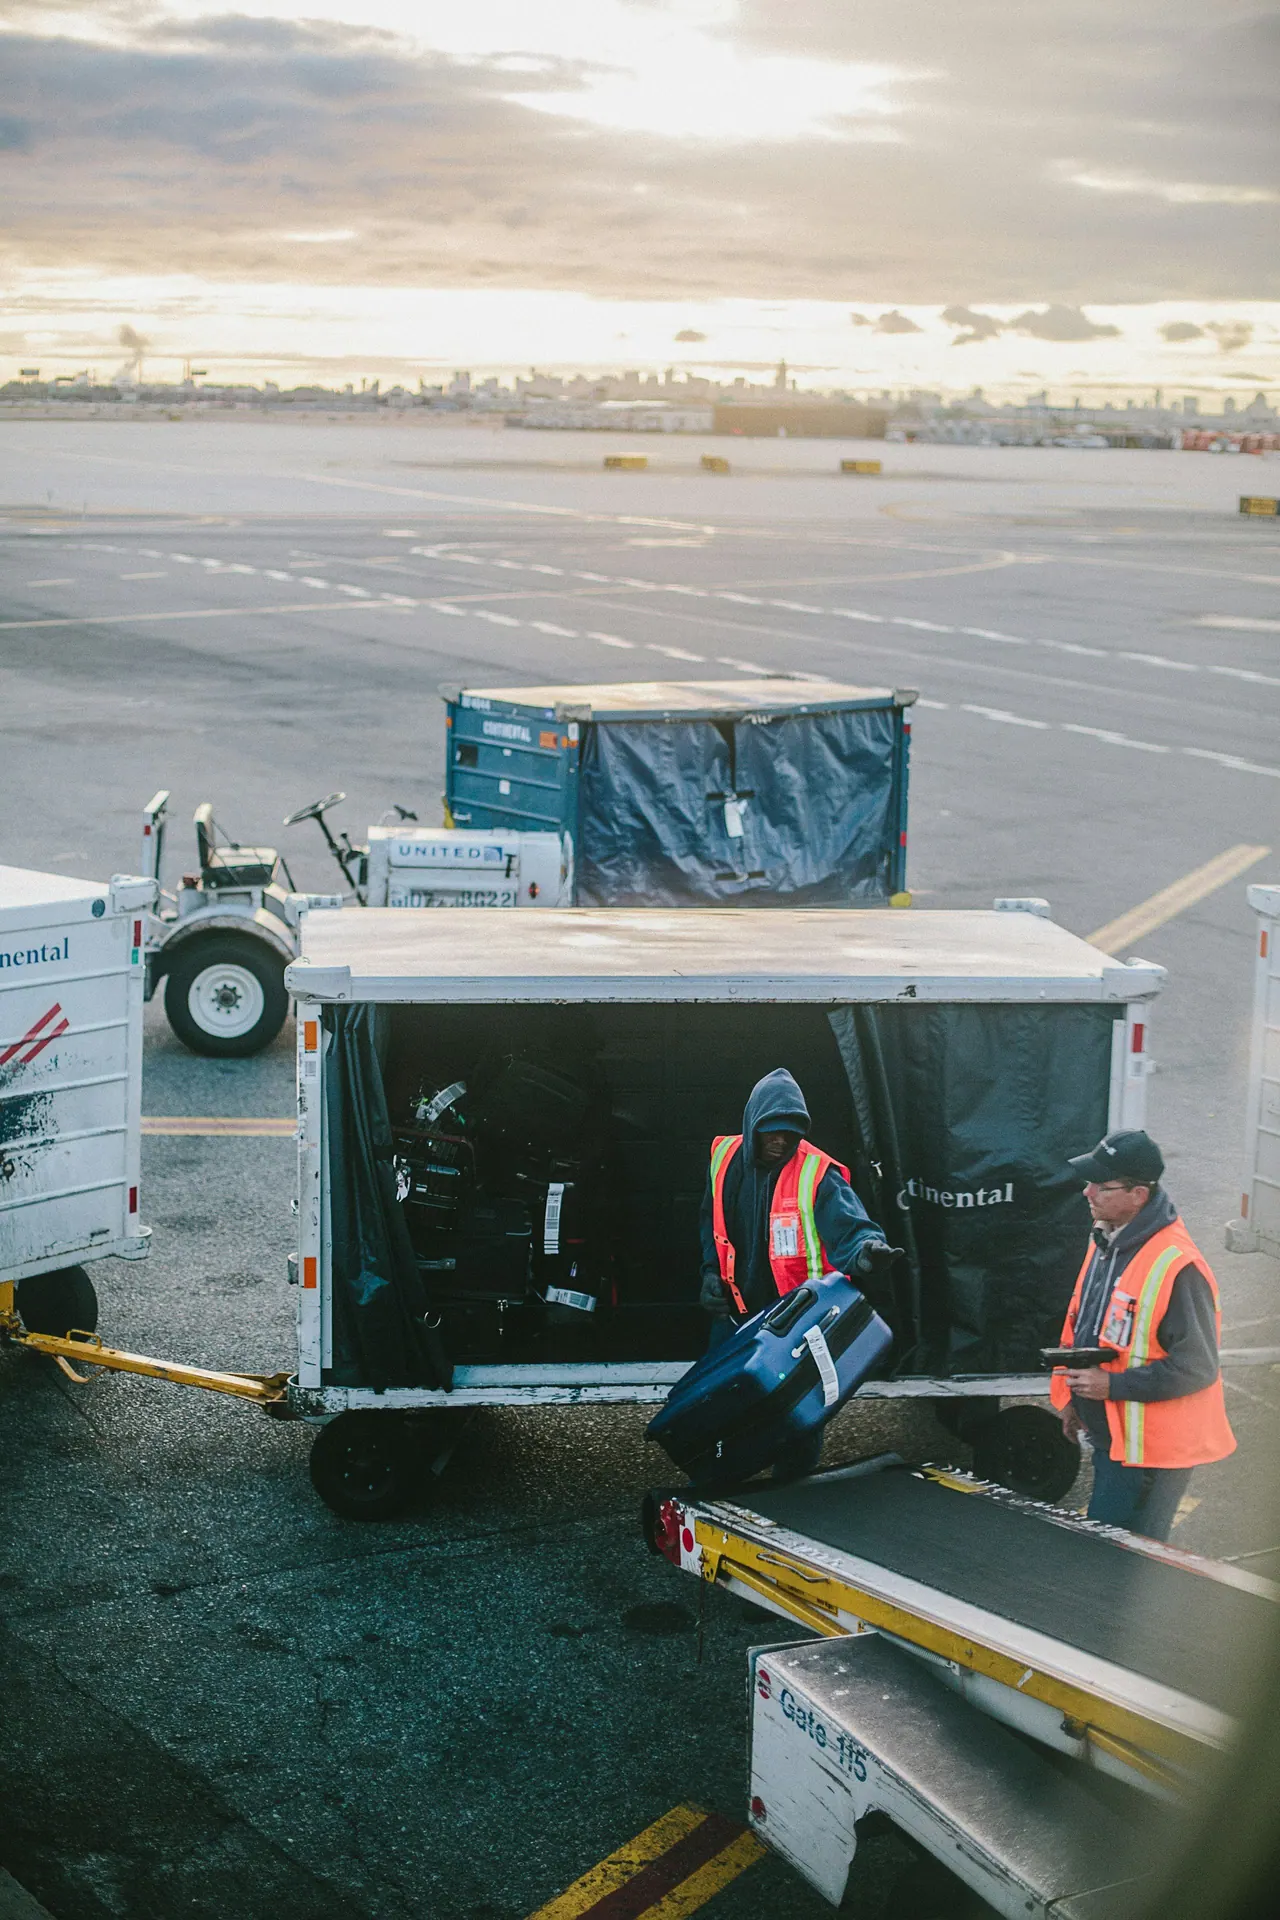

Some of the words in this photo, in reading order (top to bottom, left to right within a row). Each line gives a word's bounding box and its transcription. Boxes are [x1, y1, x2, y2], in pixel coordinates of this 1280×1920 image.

[399, 845, 481, 859] UNITED
[0, 936, 69, 968] nental
[780, 1688, 827, 1748] Gate
